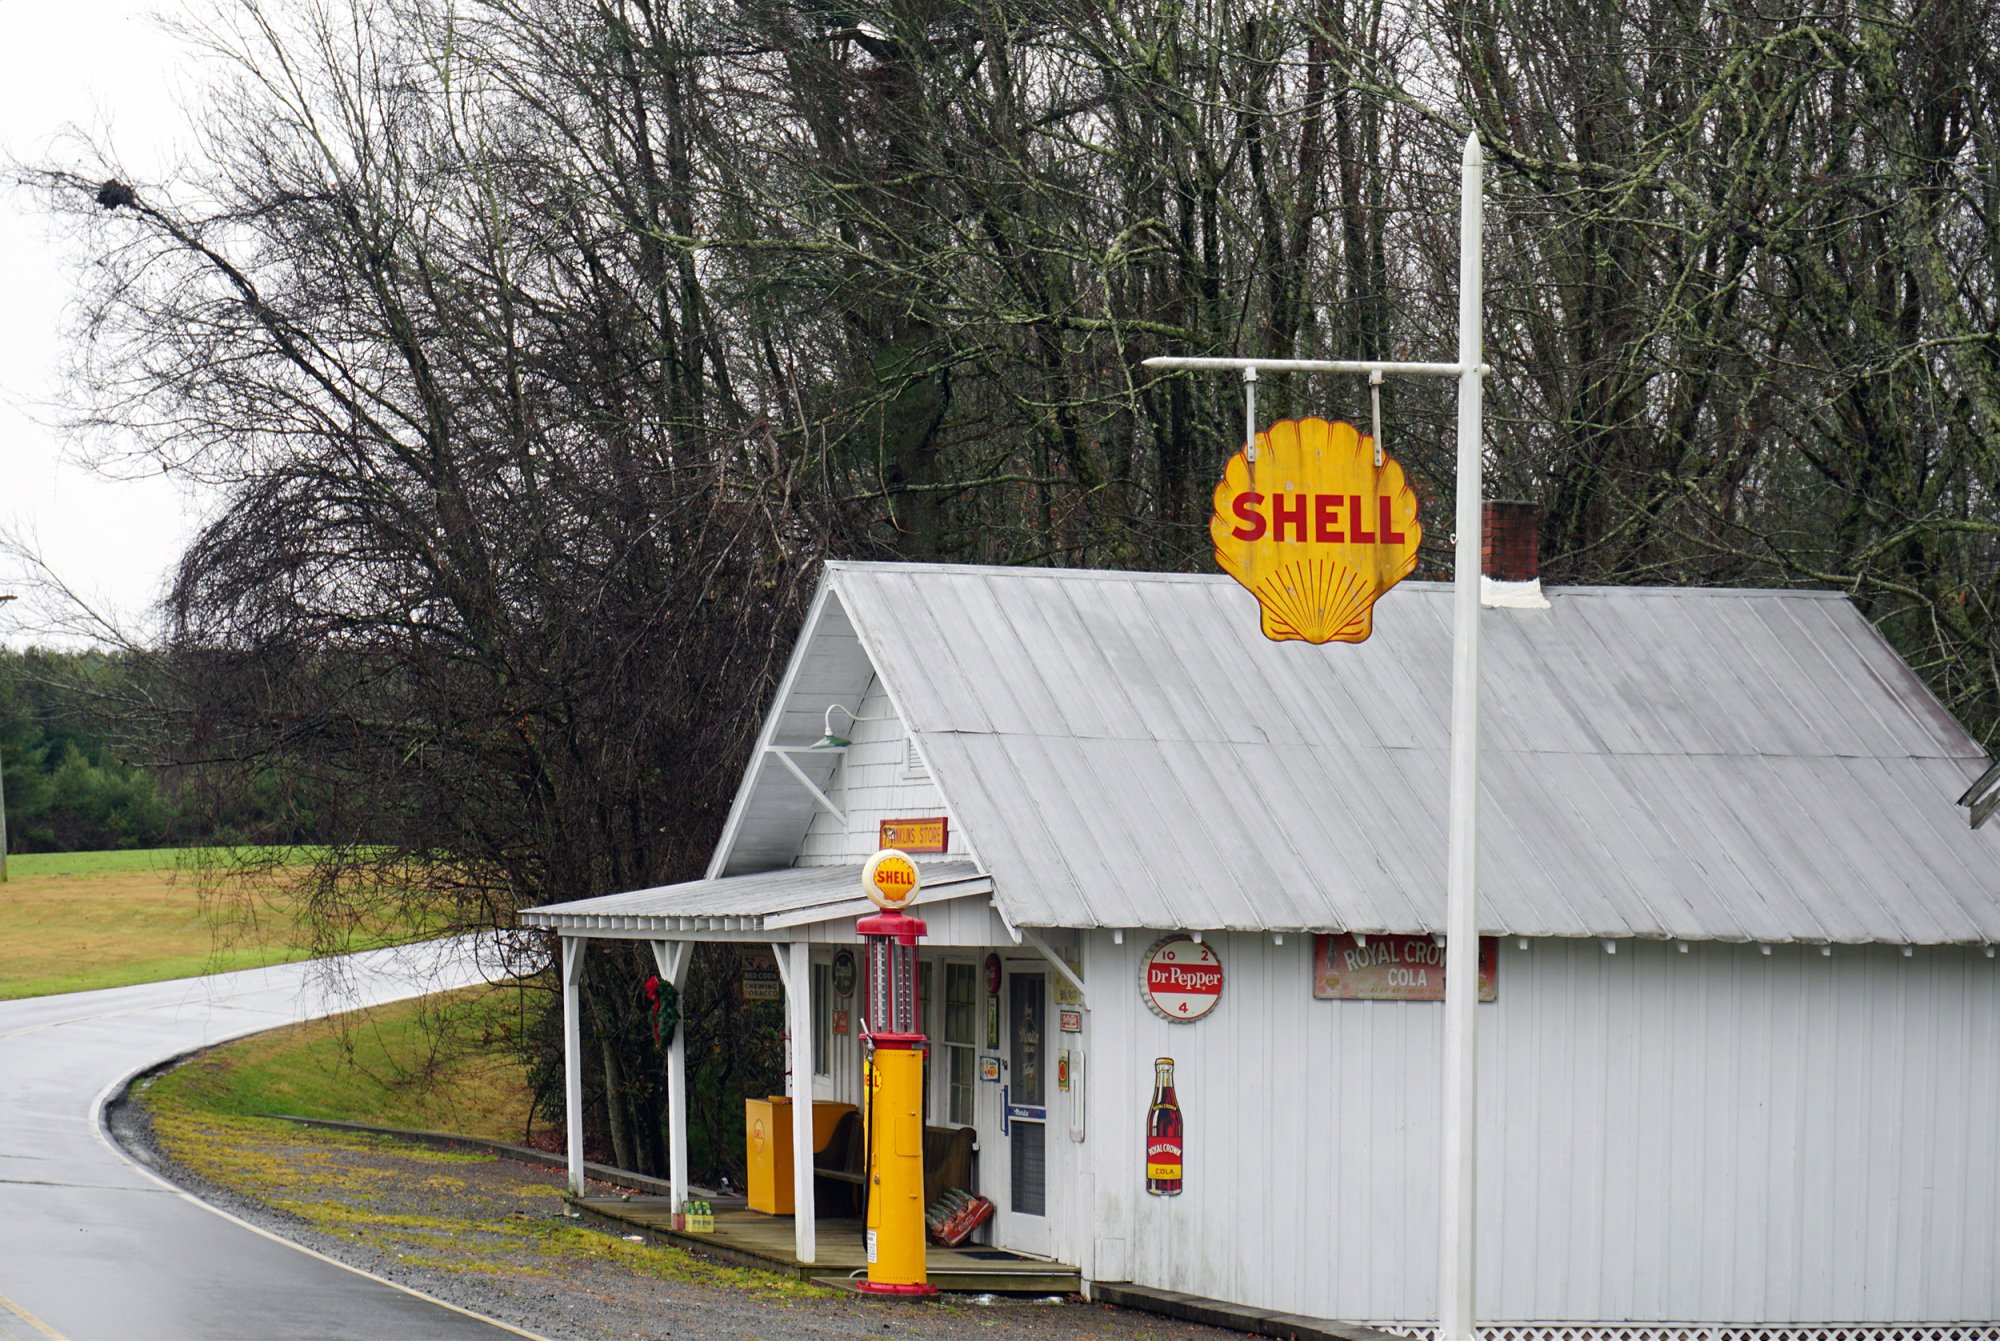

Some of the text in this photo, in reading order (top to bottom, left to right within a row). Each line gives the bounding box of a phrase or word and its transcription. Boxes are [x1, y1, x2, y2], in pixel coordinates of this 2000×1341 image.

[1231, 491, 1405, 544] SHELL
[920, 826, 941, 843] STORE
[877, 870, 912, 885] SHELL
[1162, 951, 1176, 961] 10
[1201, 950, 1209, 961] 2
[1344, 941, 1400, 972] ROYAL
[1151, 967, 1221, 990] Dr Pepper
[1387, 968, 1428, 987] COLA
[1178, 1002, 1188, 1013] 4
[1148, 1143, 1182, 1157] ROYAL CROWN
